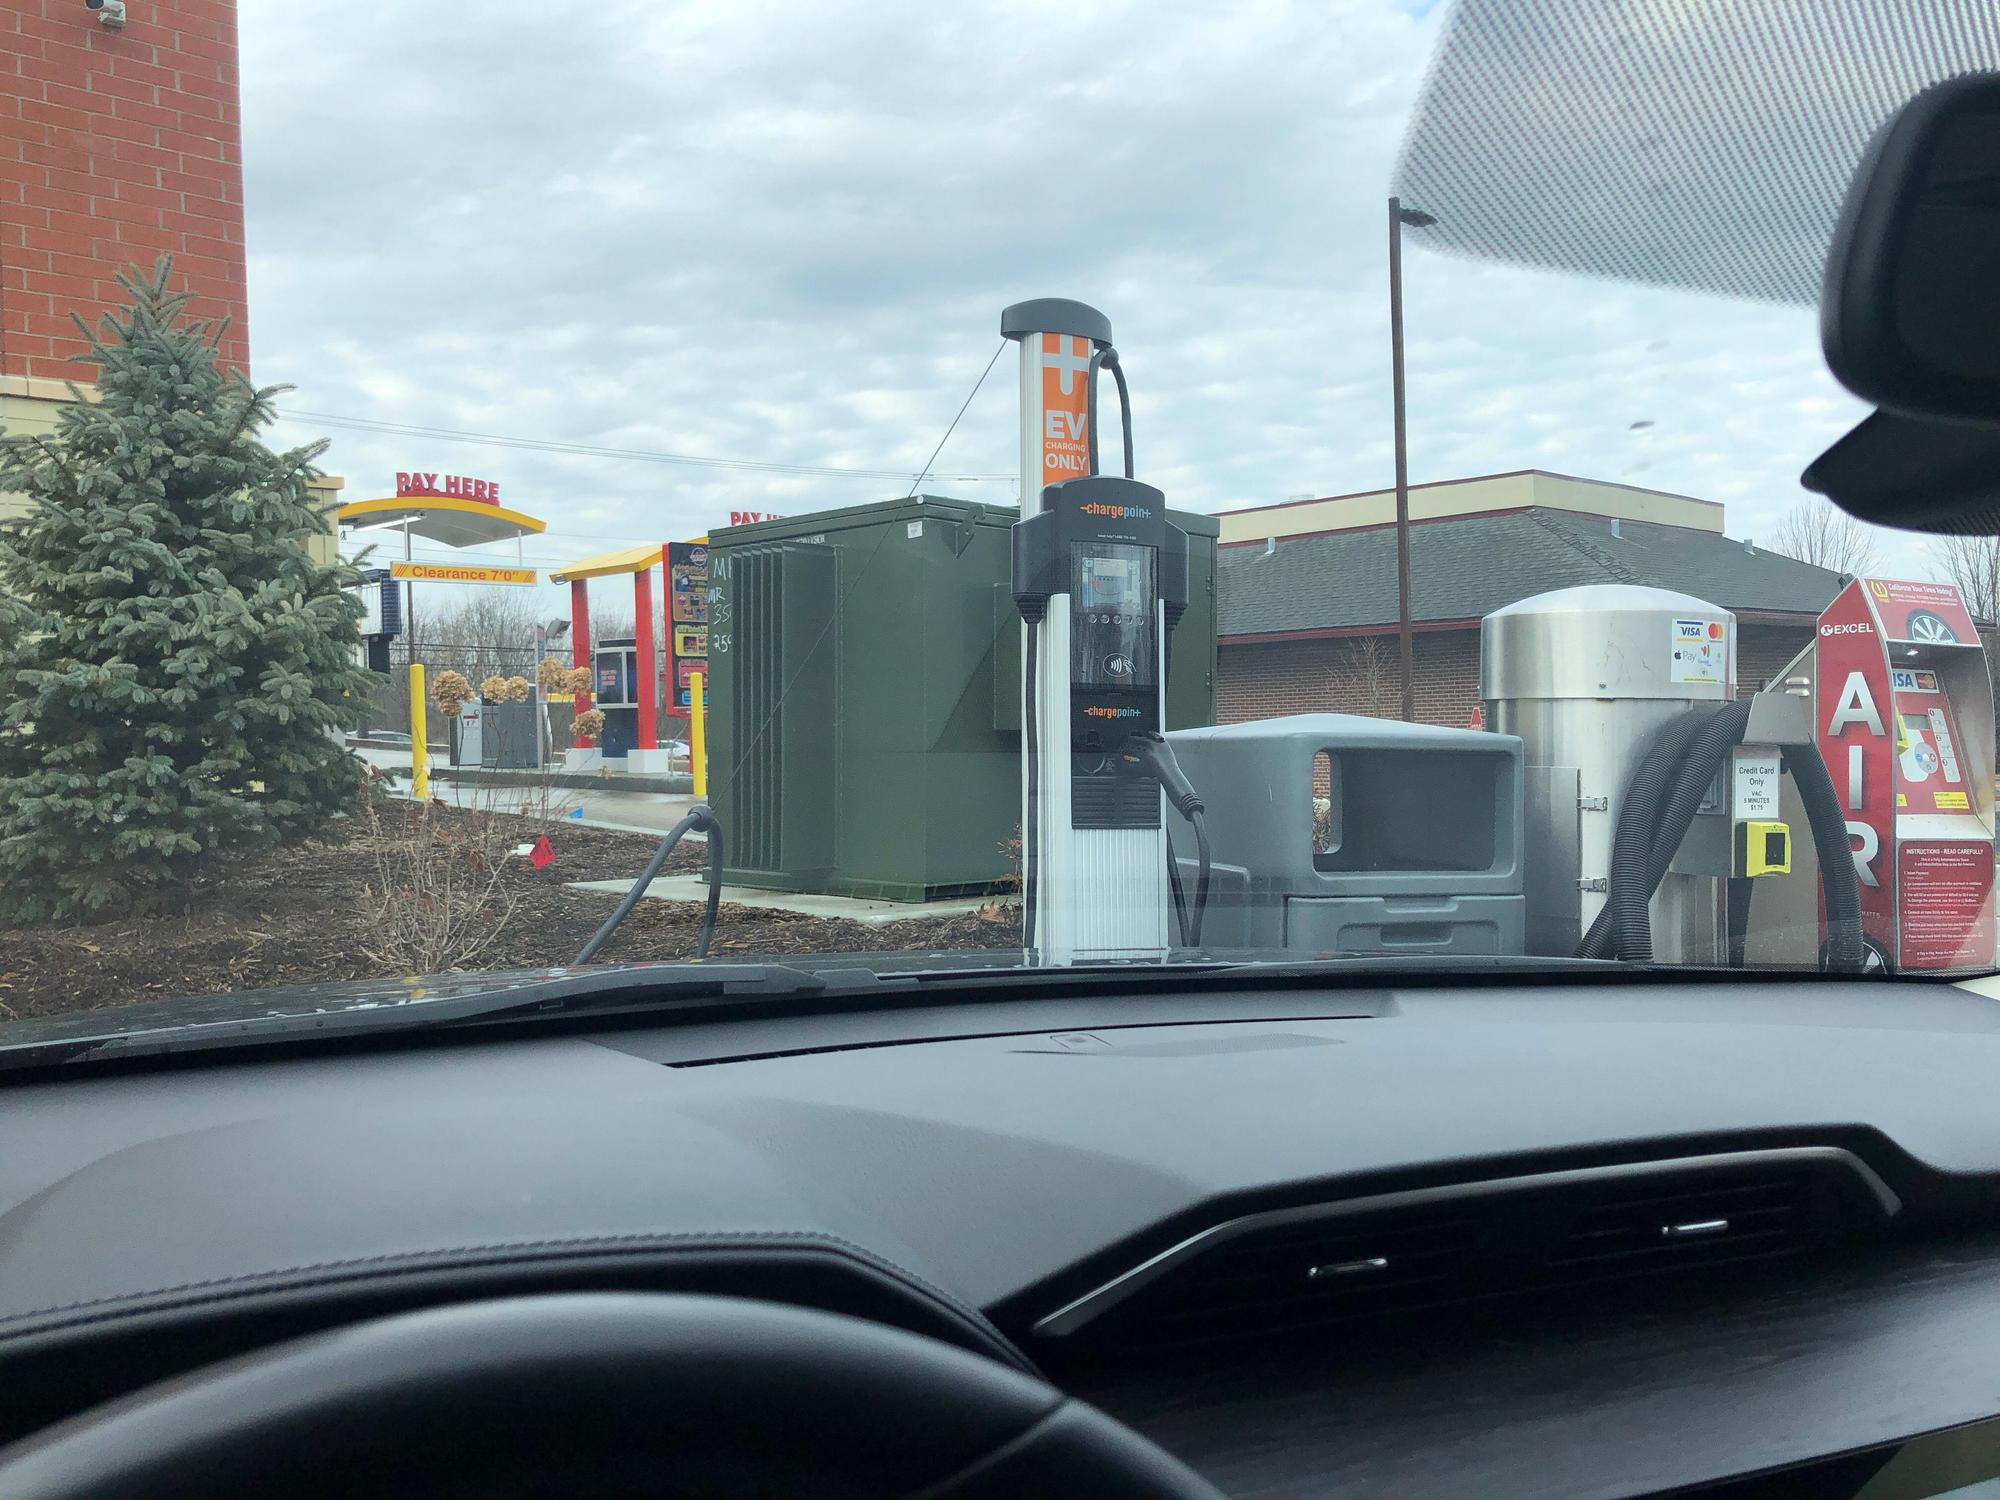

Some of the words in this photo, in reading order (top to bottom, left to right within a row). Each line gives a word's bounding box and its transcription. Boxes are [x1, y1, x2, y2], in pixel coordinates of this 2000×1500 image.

[1045, 409, 1087, 441] EV
[1045, 441, 1086, 453] CHARGING
[1045, 453, 1087, 471] ONLY
[396, 472, 439, 495] PAY
[445, 475, 501, 501] HERE
[730, 511, 762, 527] PAY
[411, 565, 487, 581] Clearance
[1680, 626, 1701, 637] VISA
[1833, 622, 1874, 635] EXCEL
[1682, 650, 1697, 664] Pay
[1893, 672, 1915, 688] ISA
[1738, 766, 1758, 775] Credit
[1759, 766, 1775, 775] Card
[1749, 777, 1765, 787] Only
[1957, 848, 1984, 856] CAREFULLY
